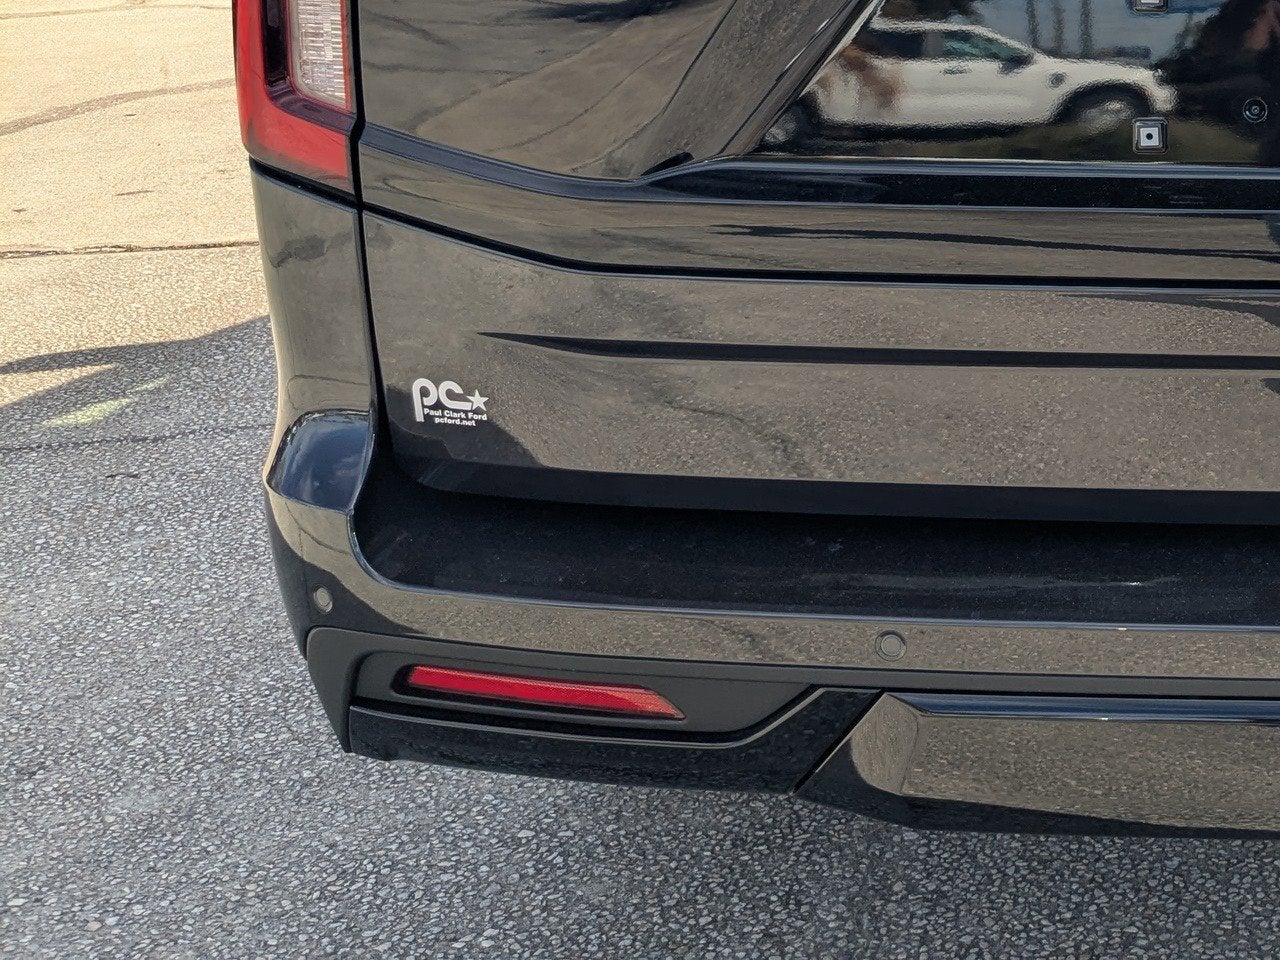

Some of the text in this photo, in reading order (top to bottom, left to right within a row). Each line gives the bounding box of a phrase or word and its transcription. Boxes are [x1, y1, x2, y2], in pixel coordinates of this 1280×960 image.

[424, 408, 488, 421] Paul Clark Ford
[435, 417, 476, 426] pcford.net
